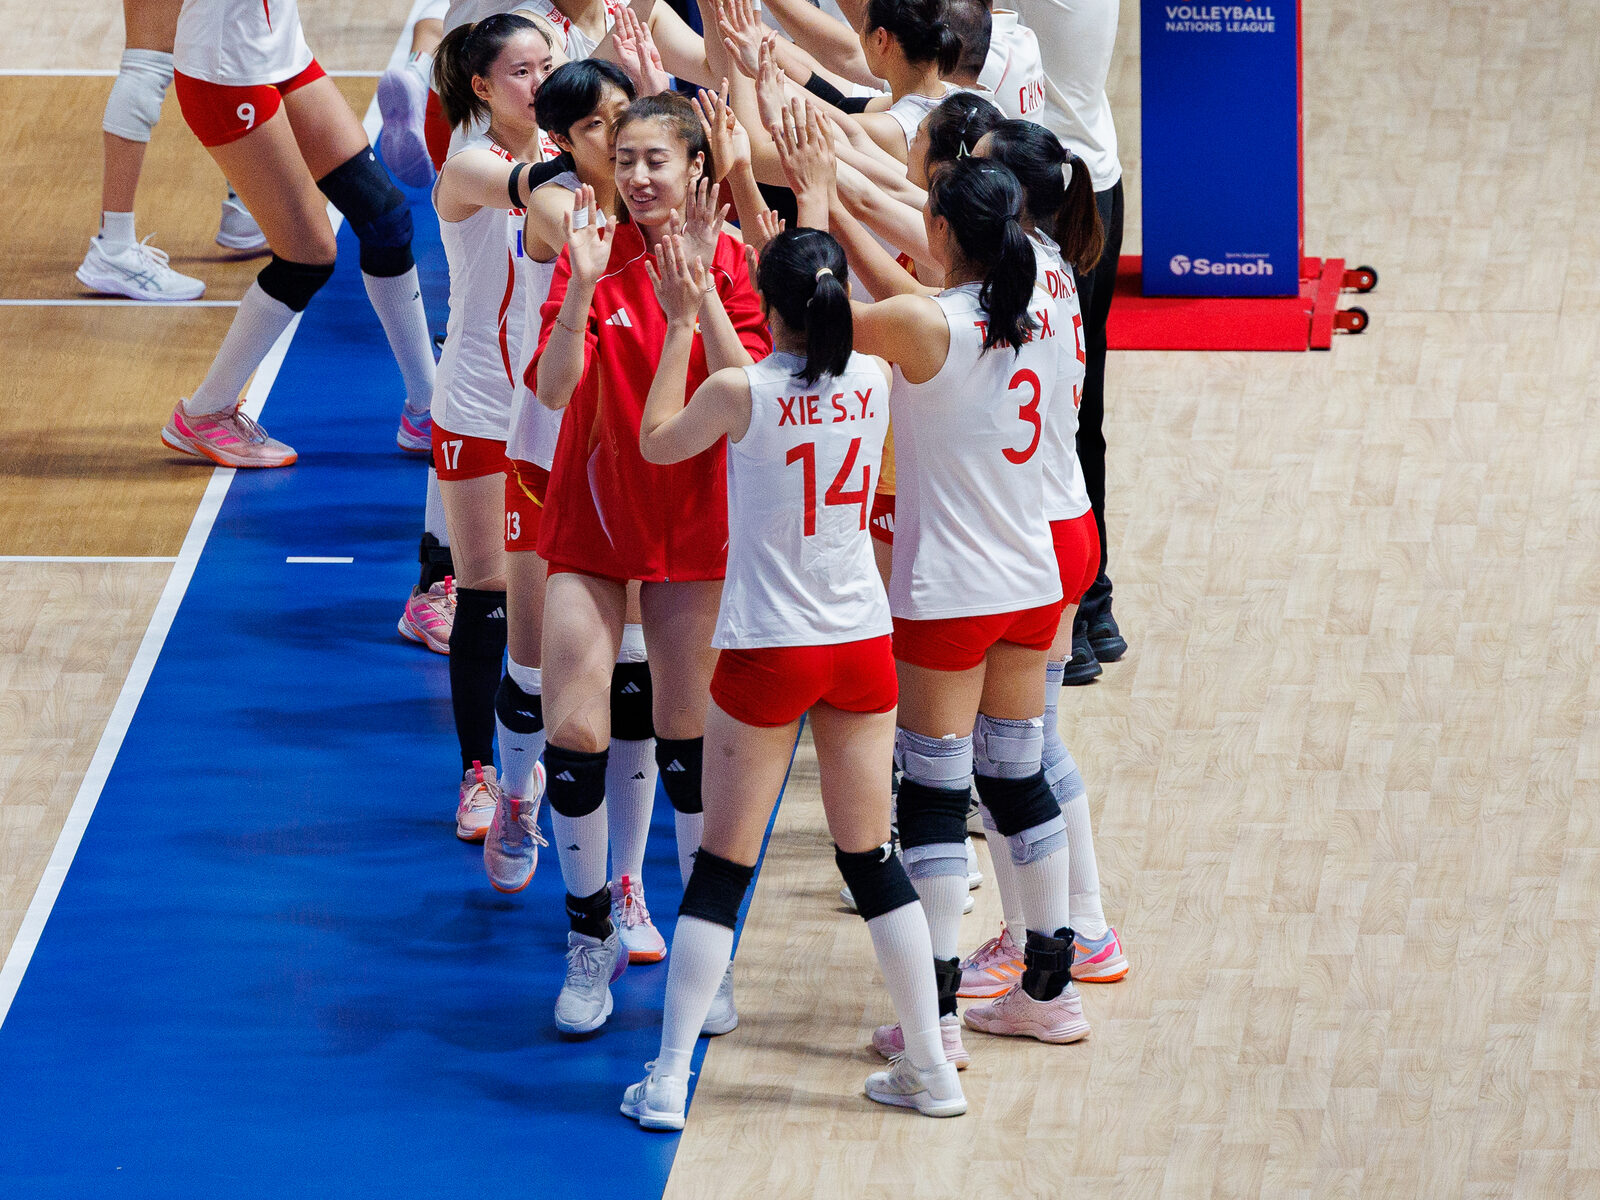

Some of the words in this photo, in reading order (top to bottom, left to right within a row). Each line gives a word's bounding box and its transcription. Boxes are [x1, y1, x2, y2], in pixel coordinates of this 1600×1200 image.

[1165, 6, 1275, 21] VOLLEYBALL
[1165, 22, 1222, 33] NATIONS
[1226, 22, 1275, 33] LEAGUE
[1019, 80, 1045, 114] CHIN
[236, 102, 256, 130] 9
[1193, 258, 1274, 275] Senoh
[777, 395, 823, 426] XIE
[831, 388, 874, 423] S.Y.
[1001, 368, 1041, 464] 3
[441, 439, 463, 470] 17
[786, 437, 870, 537] 14
[507, 511, 521, 541] 13
